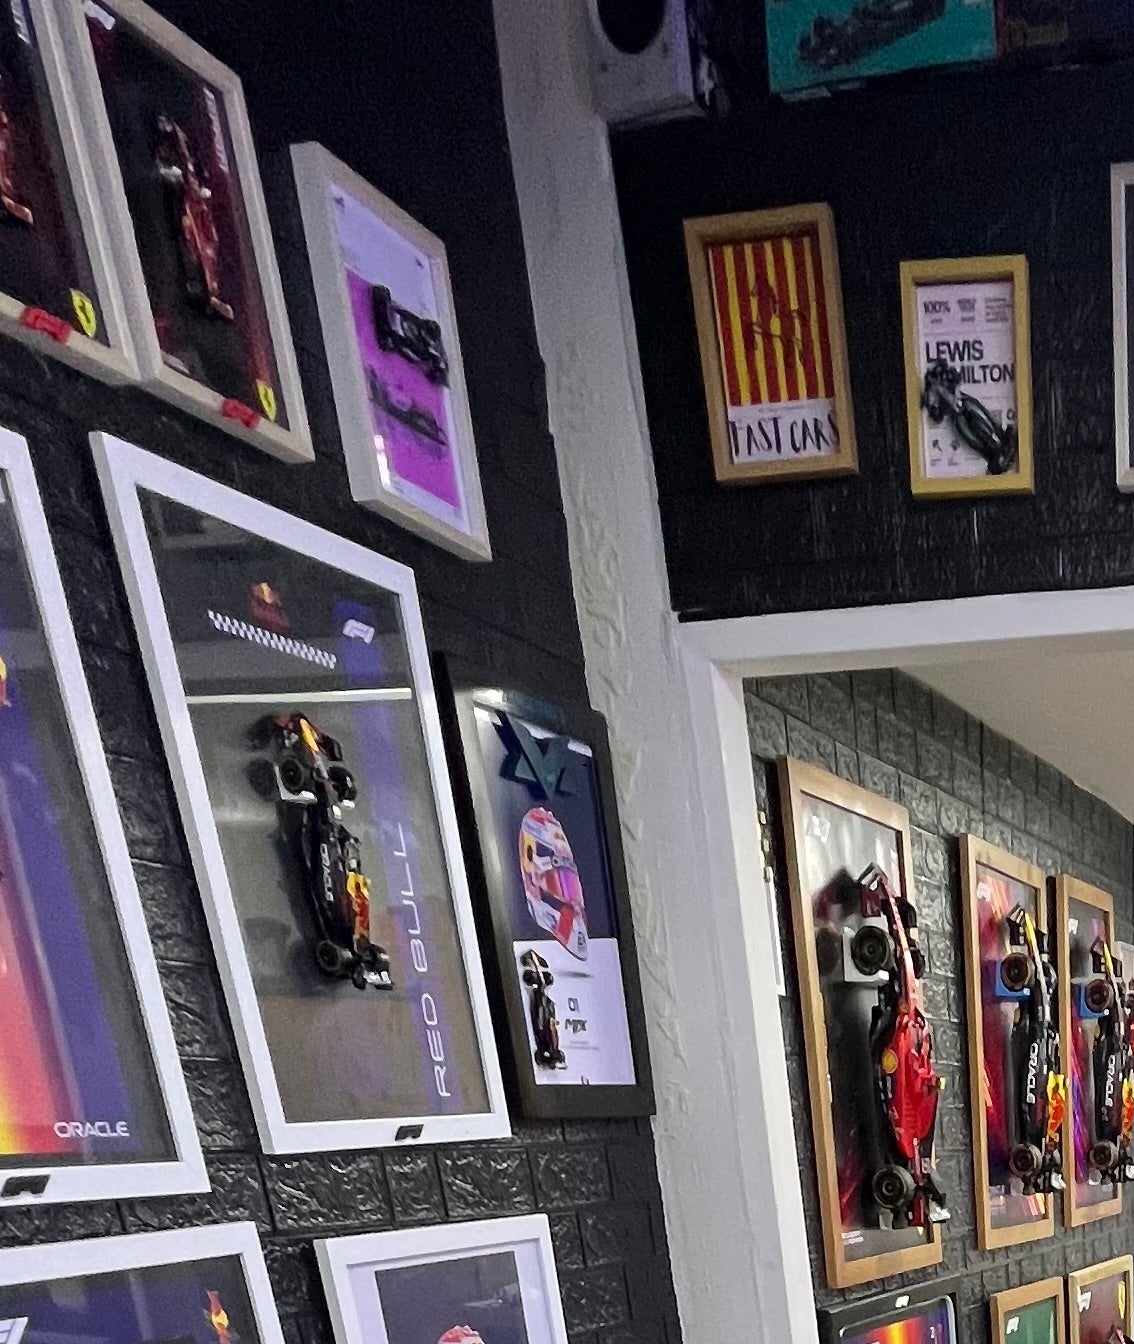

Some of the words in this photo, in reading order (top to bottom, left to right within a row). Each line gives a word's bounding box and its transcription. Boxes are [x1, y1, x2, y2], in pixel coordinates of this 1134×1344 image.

[925, 339, 984, 363] LEWIS
[393, 822, 429, 974] BULL
[420, 992, 451, 1097] RED
[1026, 1042, 1038, 1104] ORACLE
[53, 1120, 130, 1138] ORACLE
